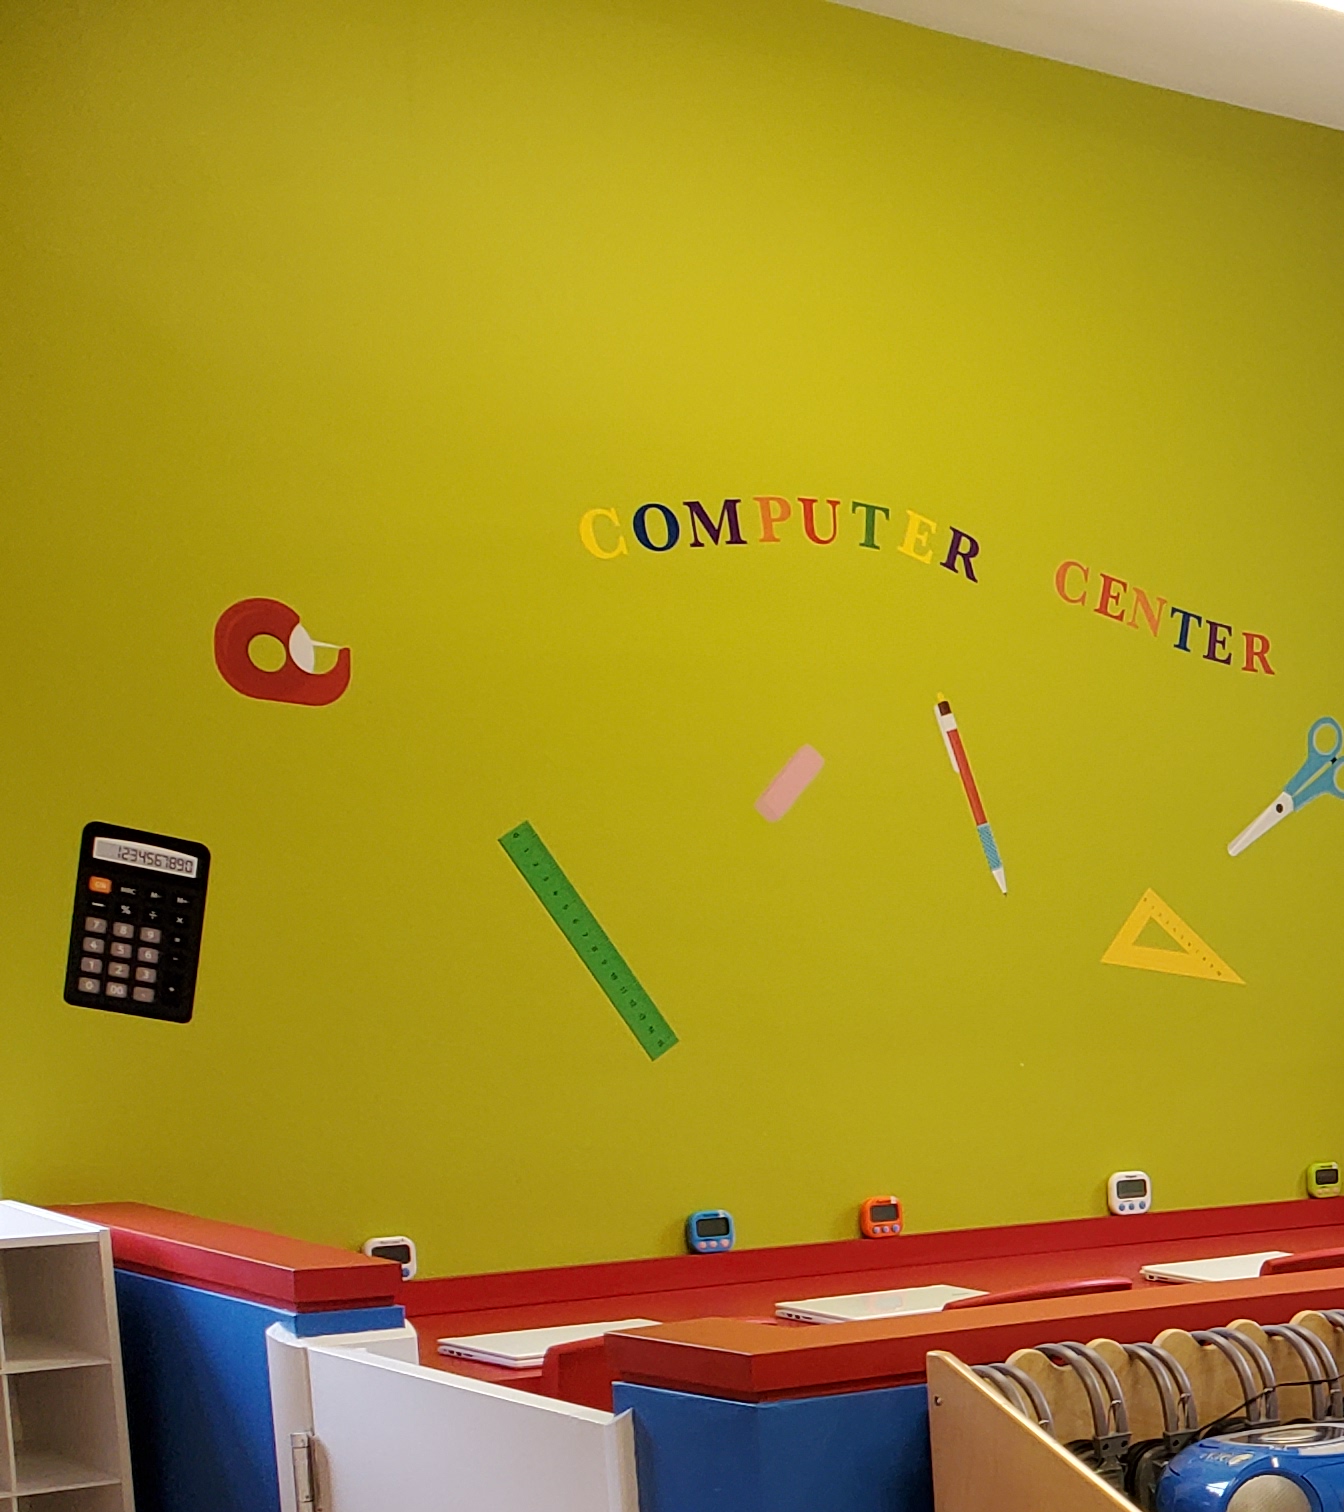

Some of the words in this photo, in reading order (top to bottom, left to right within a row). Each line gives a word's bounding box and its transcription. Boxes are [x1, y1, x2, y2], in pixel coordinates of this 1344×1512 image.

[579, 496, 980, 582] COMPUTER
[1055, 561, 1275, 675] CENTER
[117, 844, 194, 875] 1234567890
